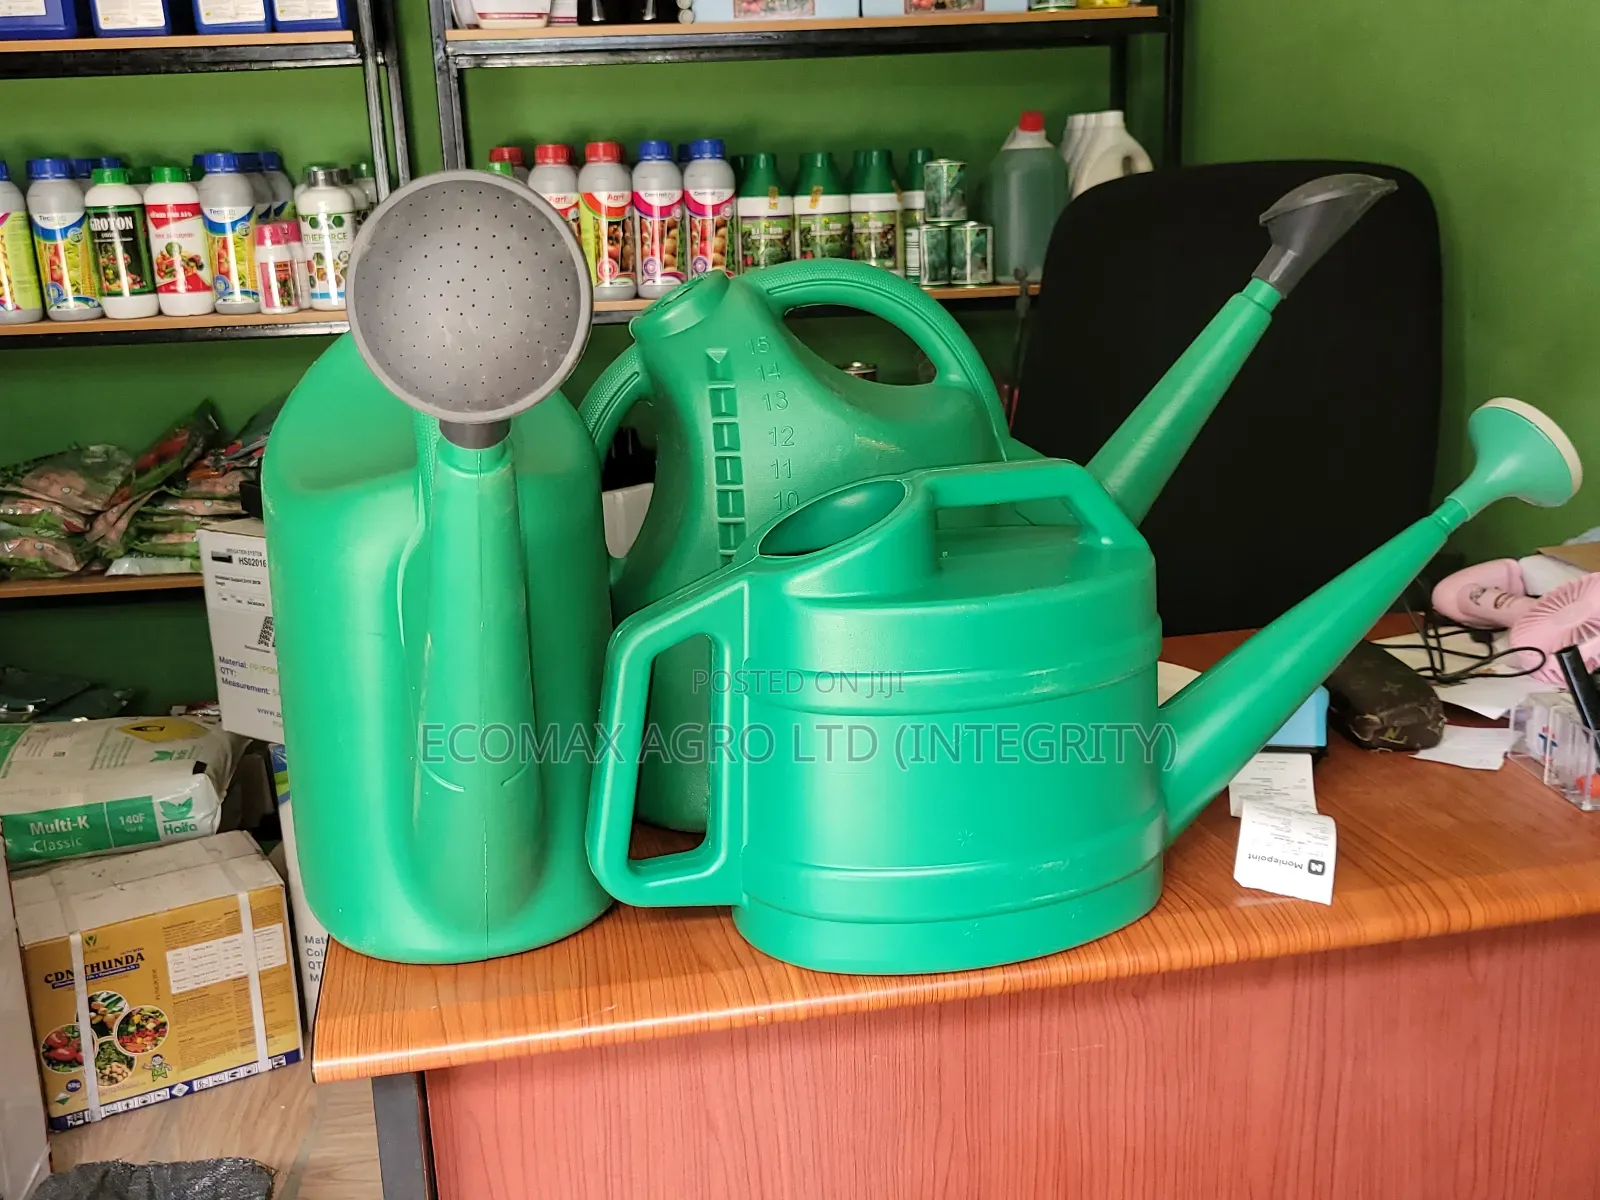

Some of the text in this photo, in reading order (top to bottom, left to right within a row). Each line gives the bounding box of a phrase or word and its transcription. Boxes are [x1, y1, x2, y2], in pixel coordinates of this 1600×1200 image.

[746, 336, 770, 355] 15
[756, 362, 781, 382] 14
[762, 391, 789, 411] 13
[768, 425, 795, 447] 12
[771, 458, 792, 479] 11
[773, 491, 799, 511] 10
[219, 656, 248, 669] Material:
[220, 667, 237, 677] QTY:
[29, 815, 90, 836] Multi-K
[119, 813, 146, 826] 140F
[164, 821, 198, 836] Haifa
[32, 836, 83, 853] Classic
[1247, 853, 1304, 869] Moniepoint
